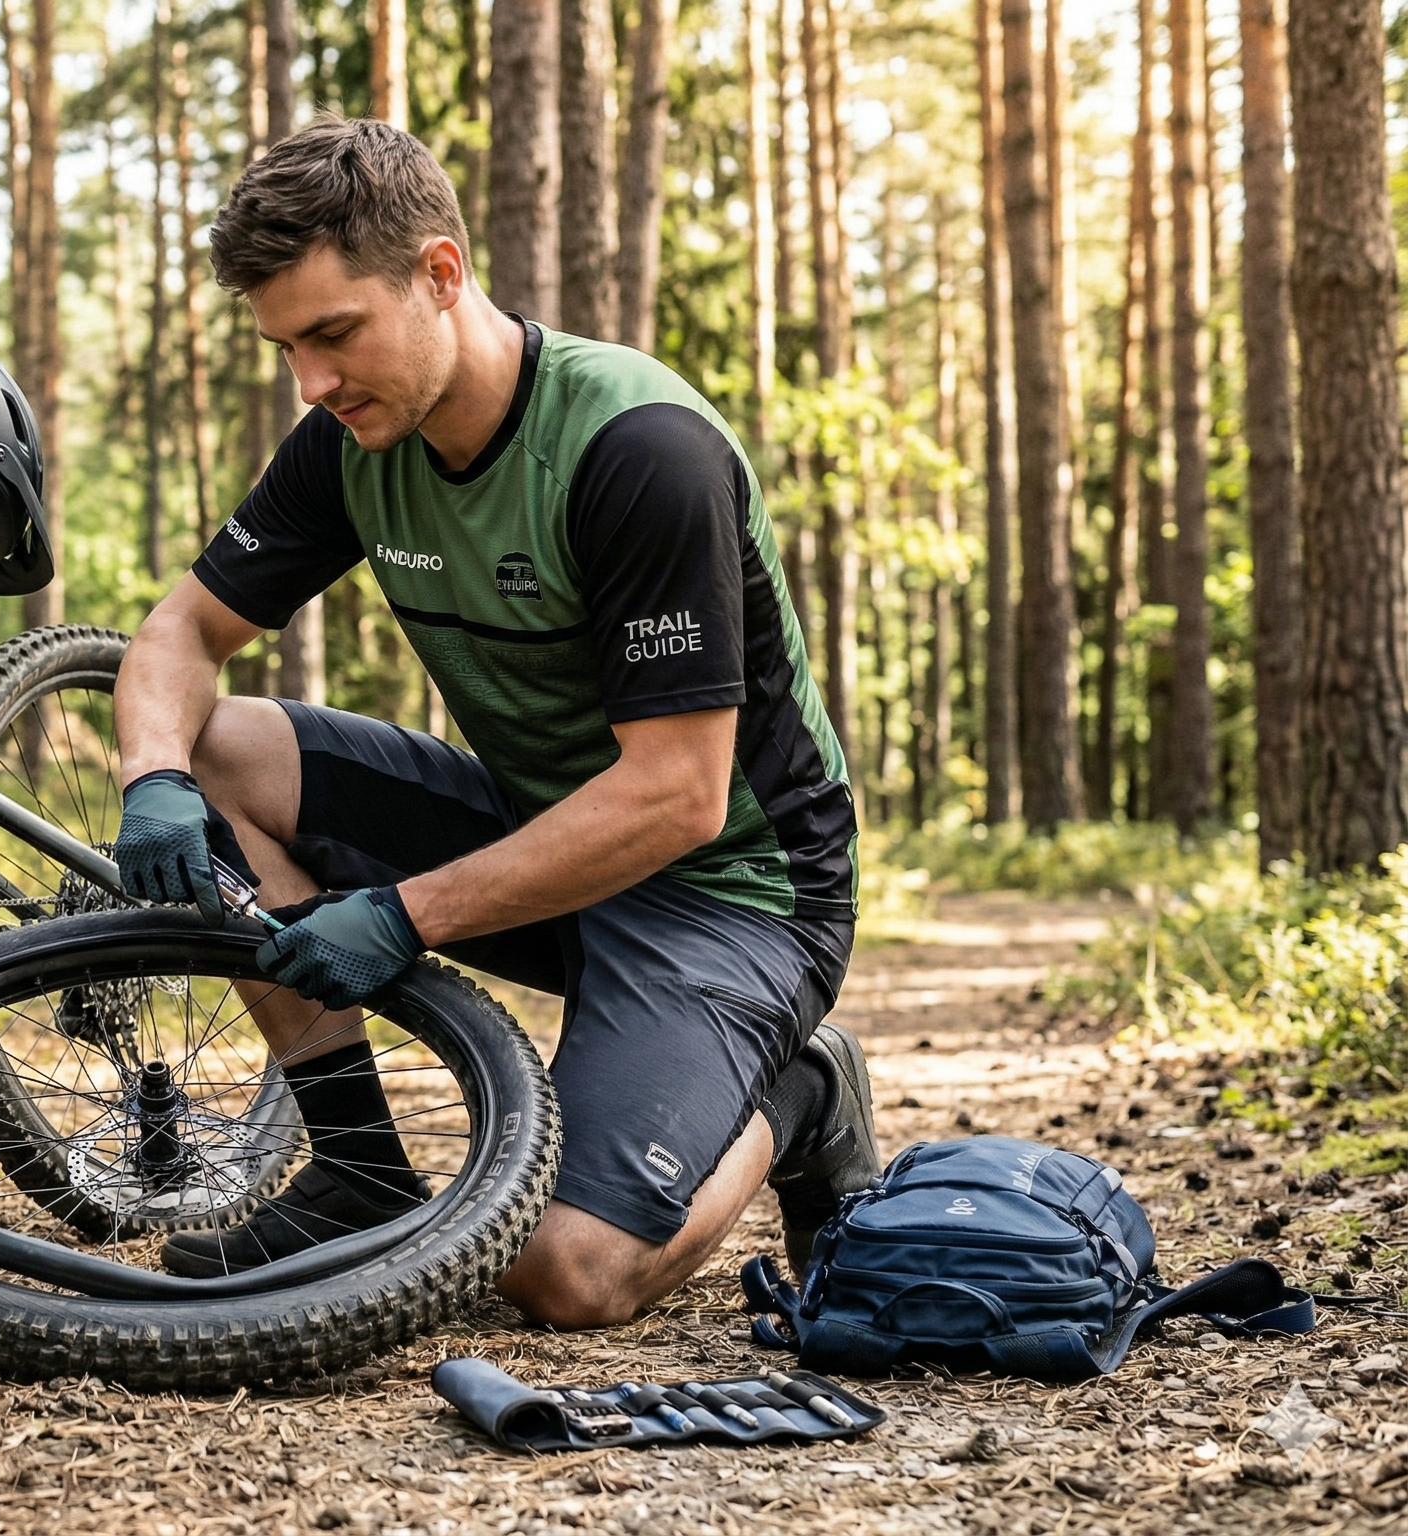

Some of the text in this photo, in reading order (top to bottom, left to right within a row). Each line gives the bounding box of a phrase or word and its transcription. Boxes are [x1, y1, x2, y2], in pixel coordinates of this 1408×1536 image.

[376, 543, 443, 571] ENDURO
[624, 610, 700, 640] TRAIL
[625, 632, 703, 662] GUIDE
